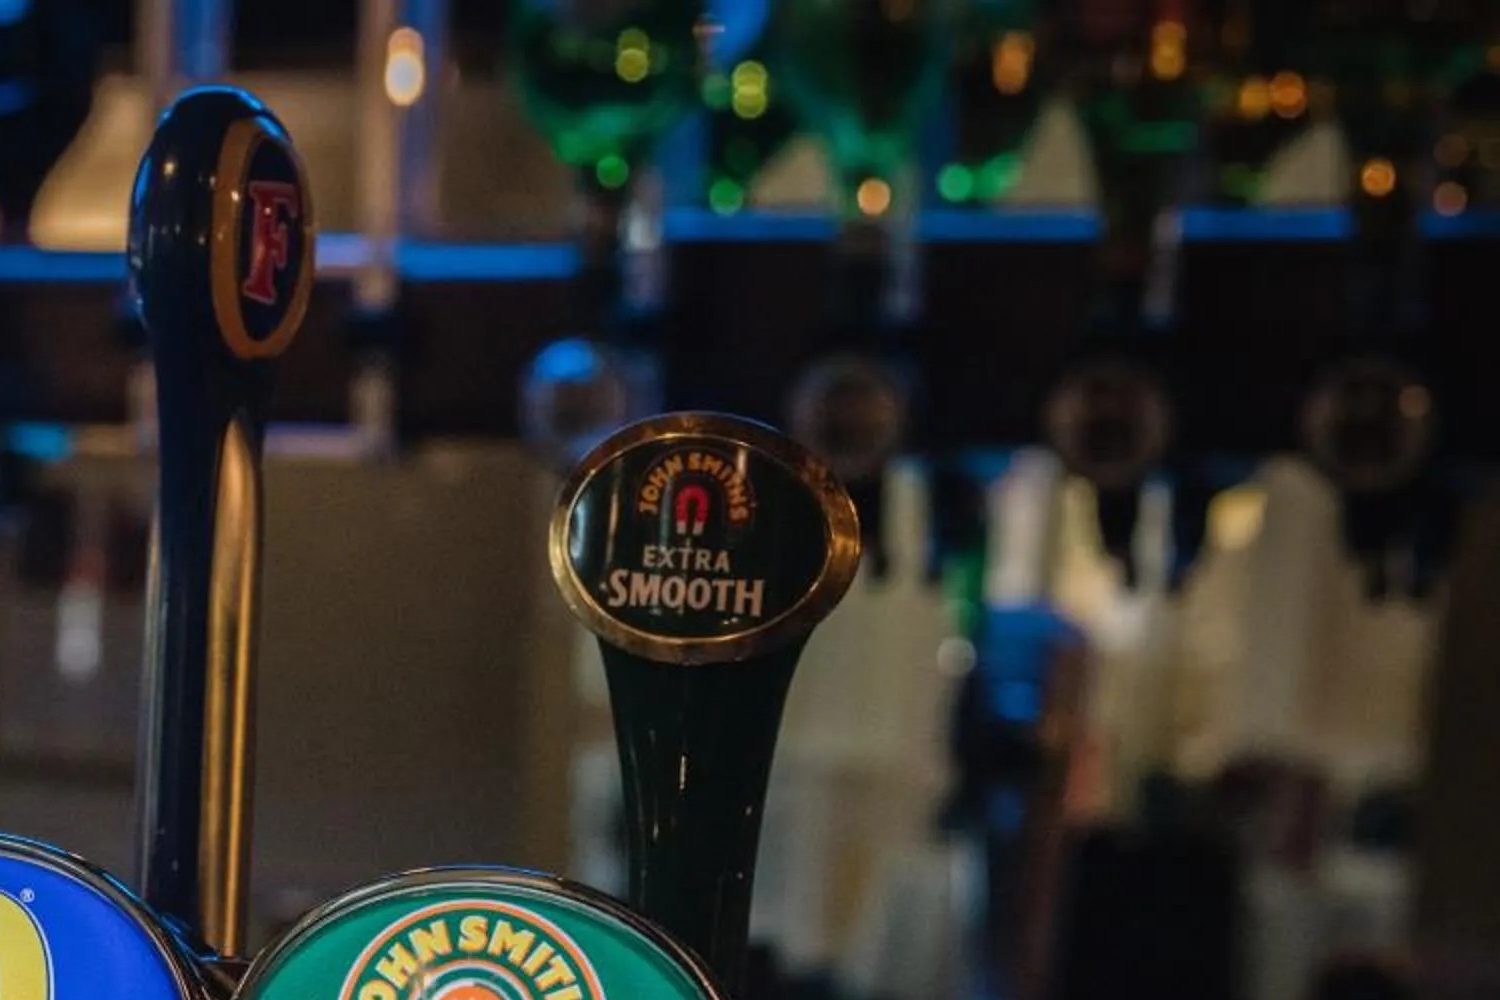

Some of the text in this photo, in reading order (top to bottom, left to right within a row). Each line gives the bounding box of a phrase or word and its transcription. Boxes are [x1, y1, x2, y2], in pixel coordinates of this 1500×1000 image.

[243, 180, 299, 305] F
[638, 453, 684, 516] JOHN
[642, 544, 731, 573] EXTRA
[607, 569, 765, 617] SMOOTH
